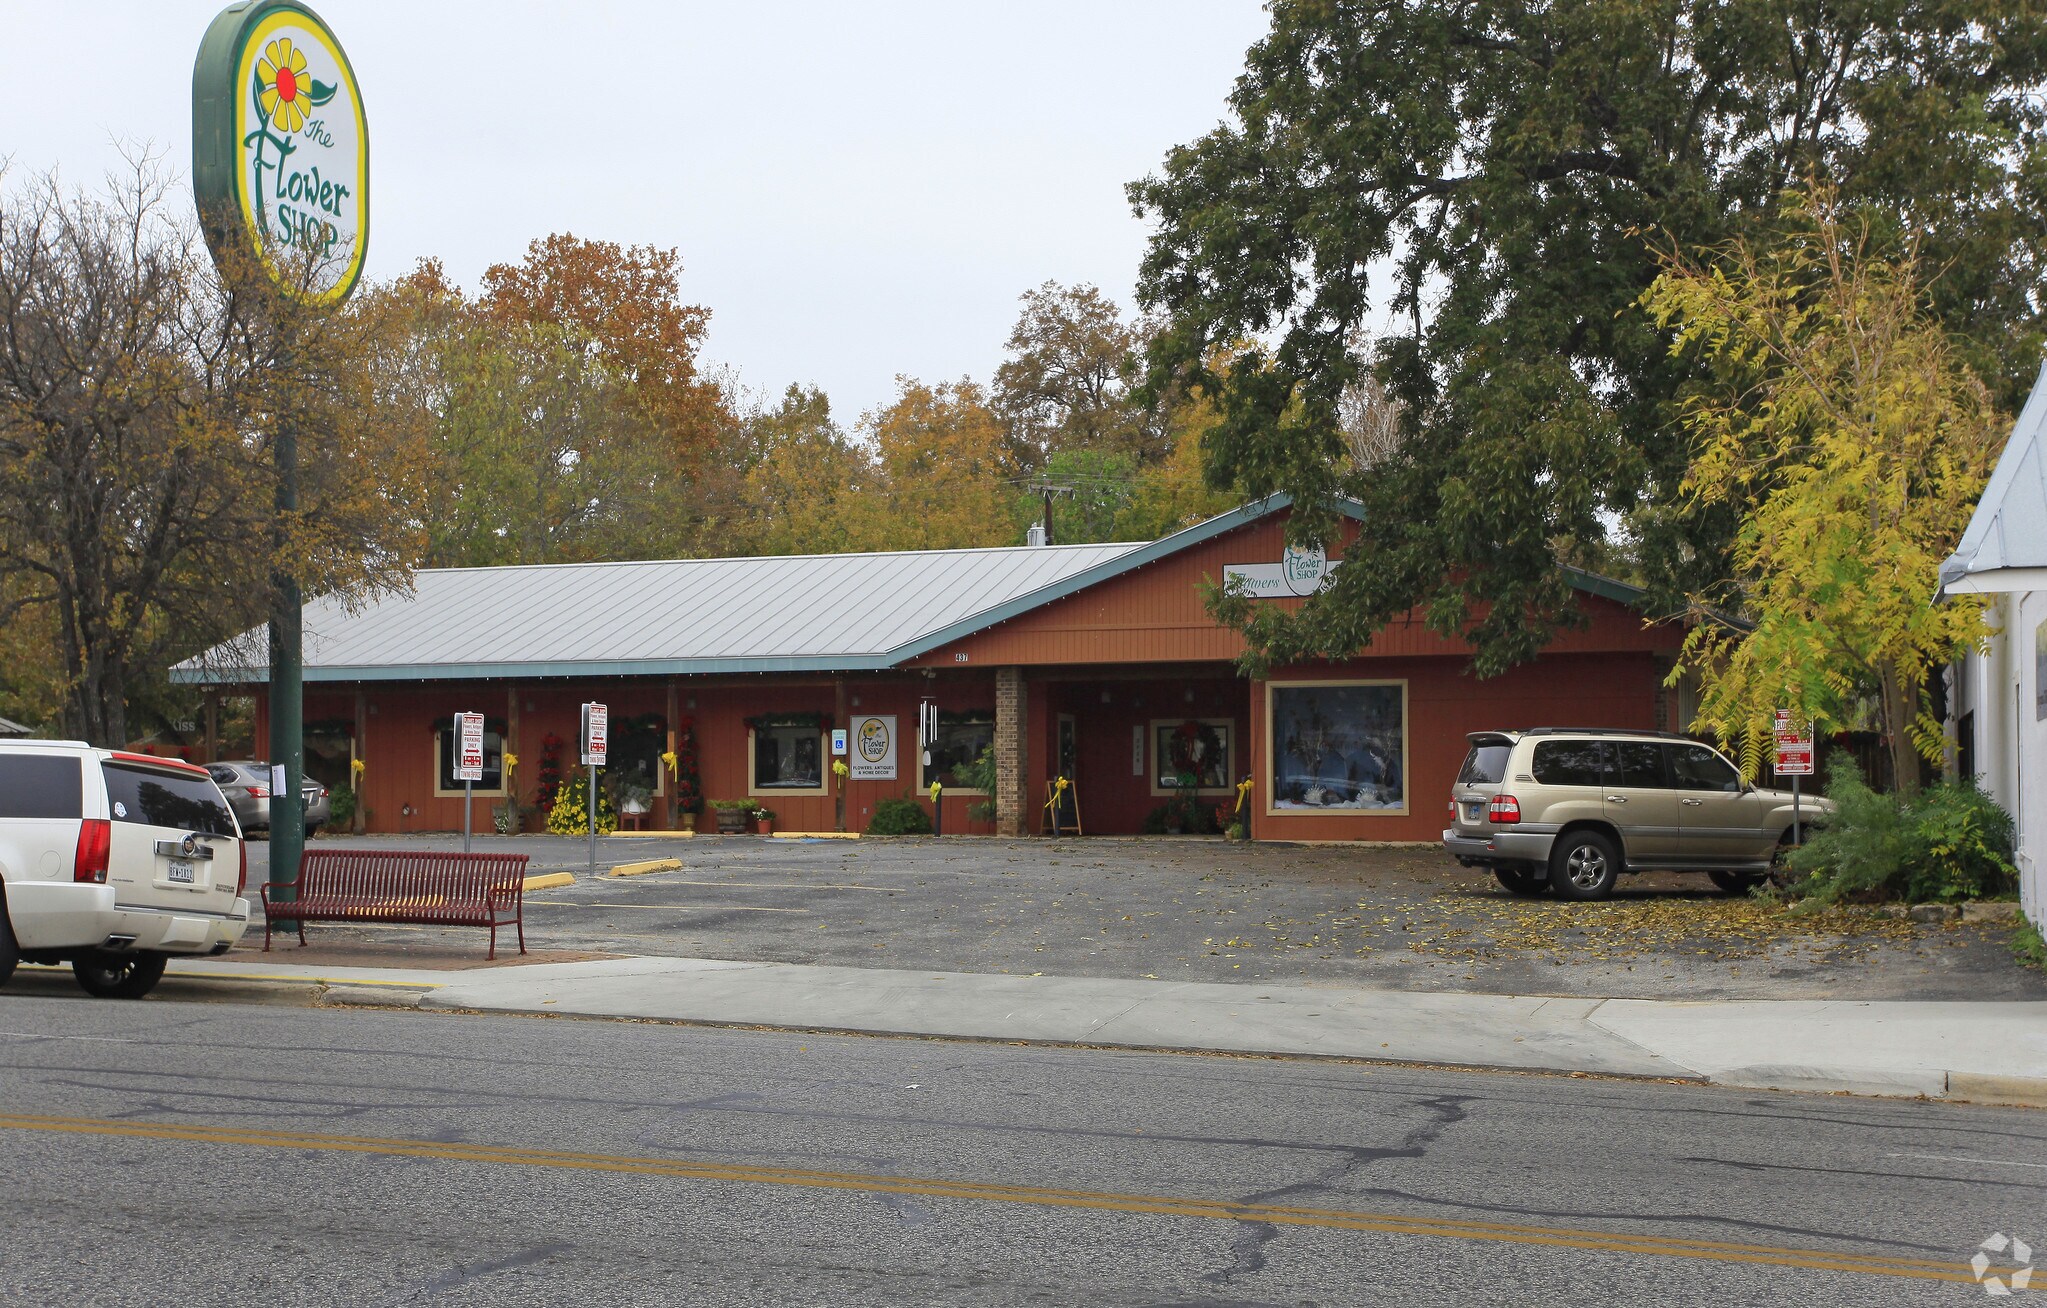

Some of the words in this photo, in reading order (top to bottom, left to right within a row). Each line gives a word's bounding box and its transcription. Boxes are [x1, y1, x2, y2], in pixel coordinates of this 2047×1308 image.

[303, 119, 335, 148] The
[243, 129, 350, 234] Flower
[277, 203, 338, 259] SHOP
[1285, 555, 1322, 581] Flower
[1297, 570, 1318, 580] SHOP
[956, 653, 968, 662] 437
[861, 737, 886, 754] Flower
